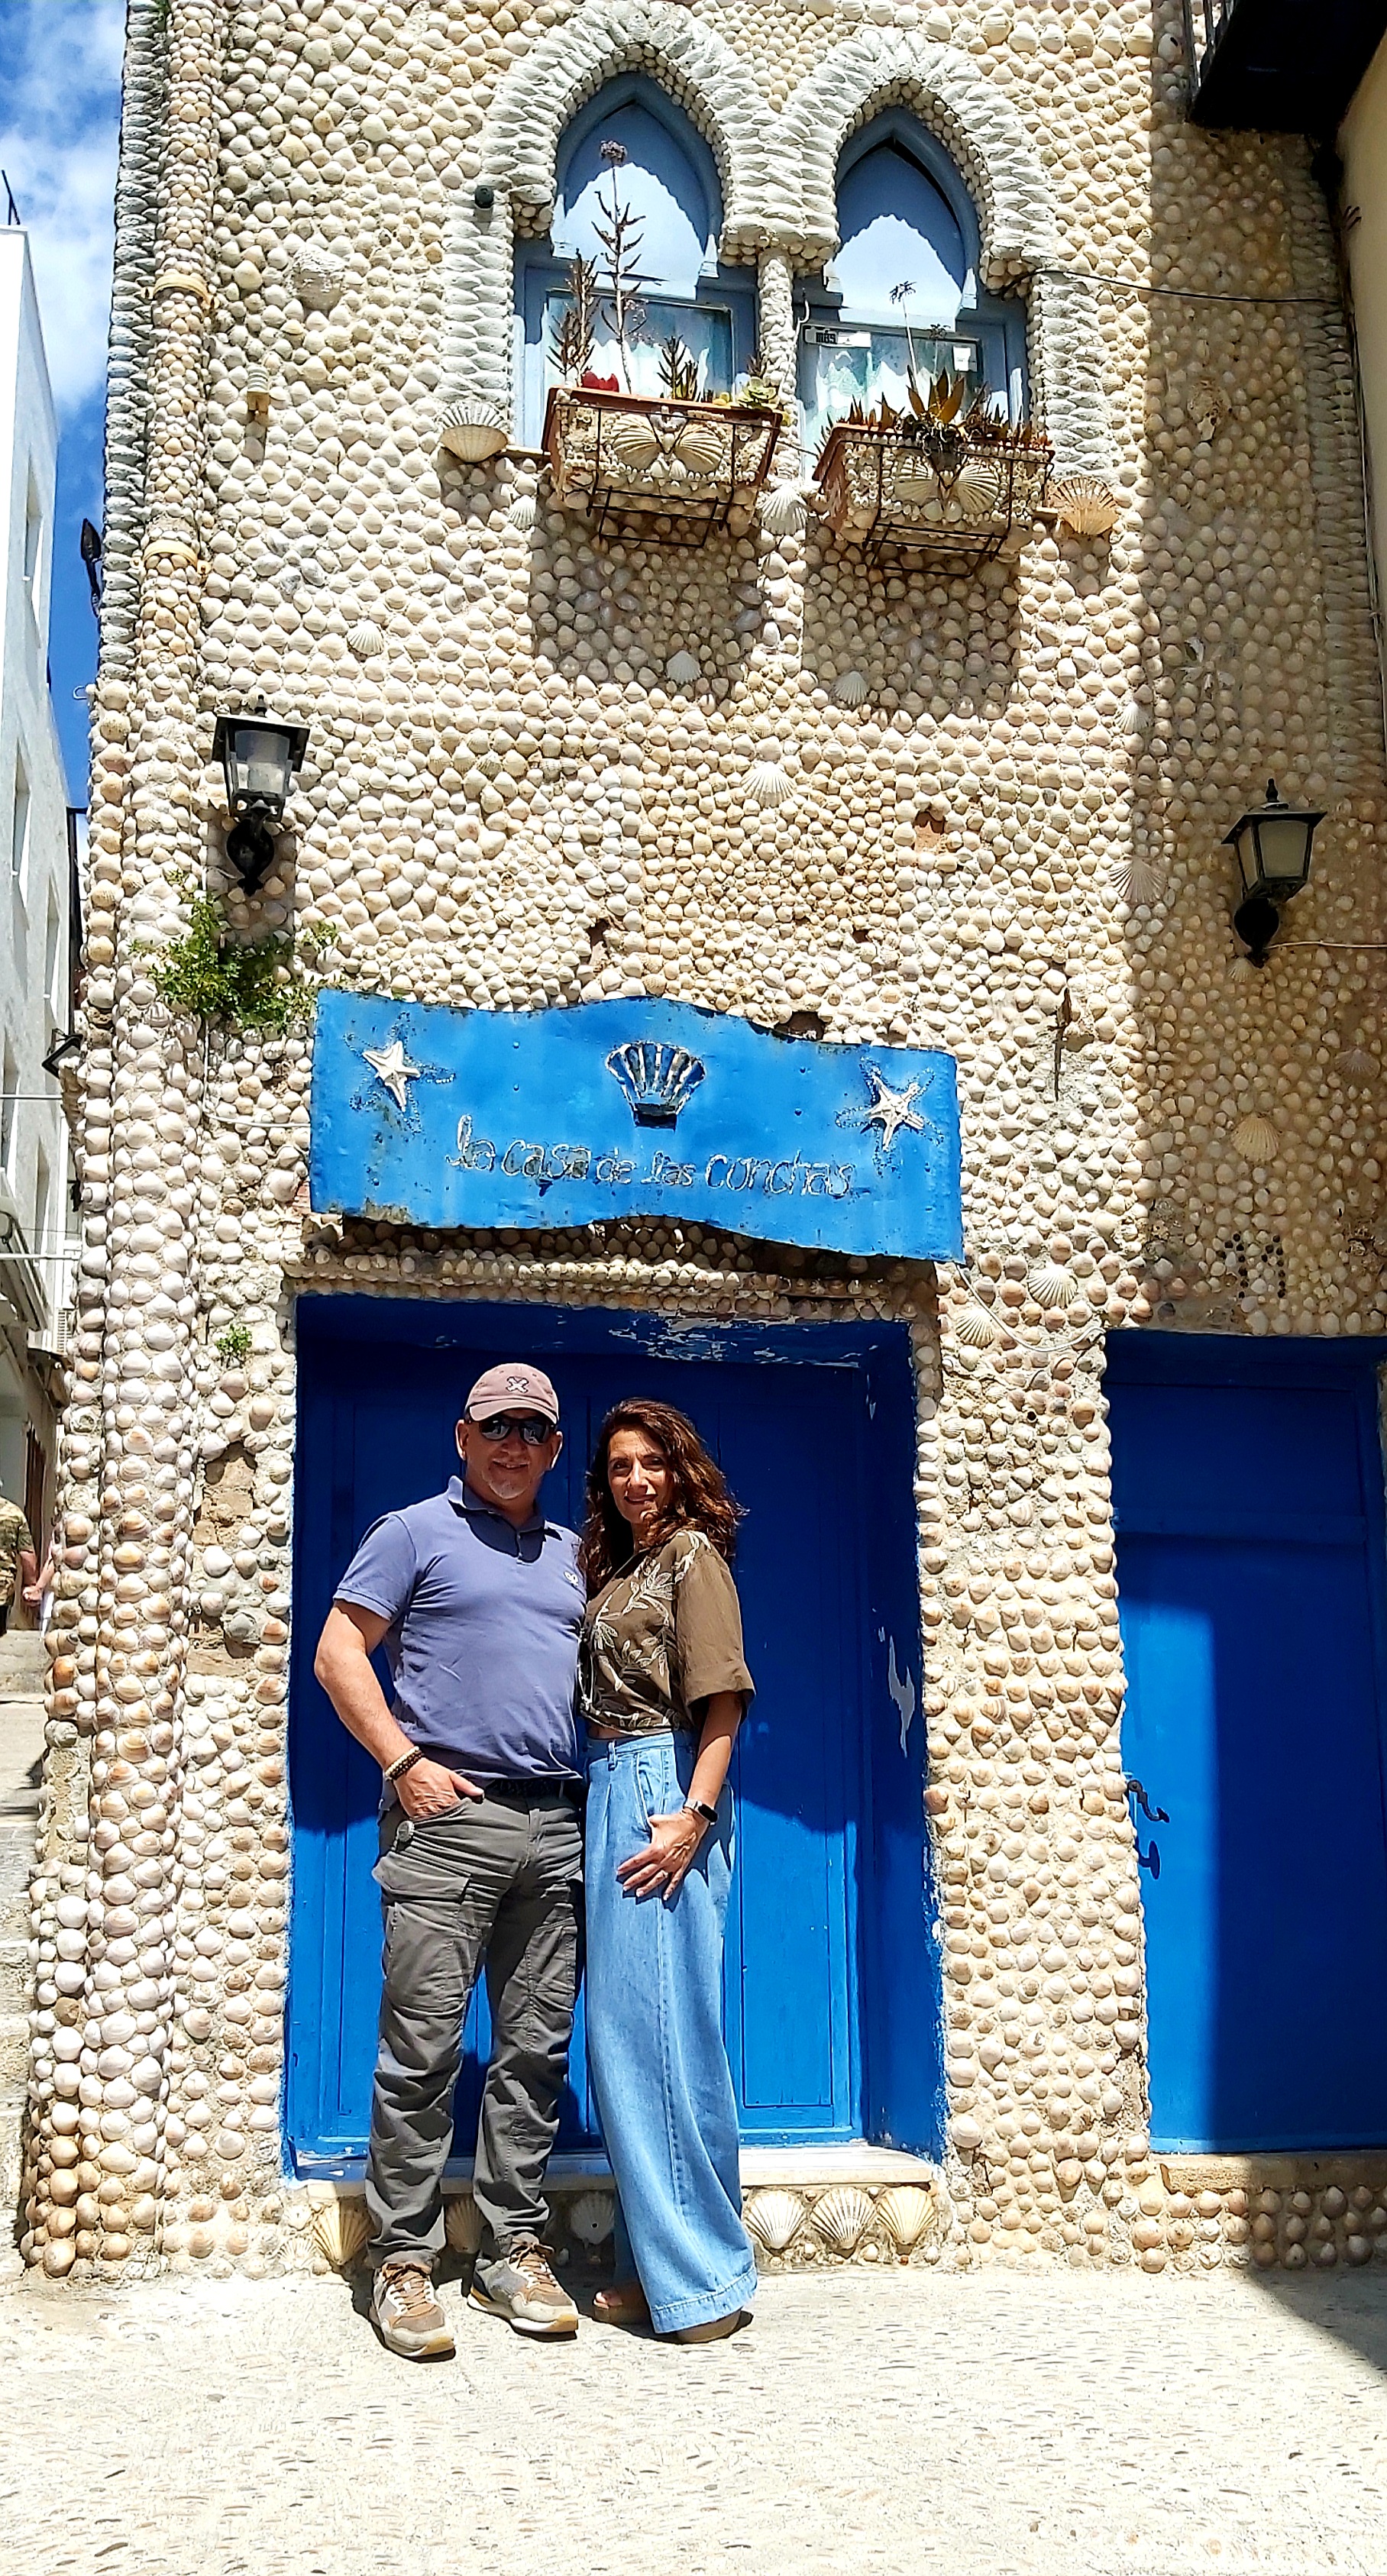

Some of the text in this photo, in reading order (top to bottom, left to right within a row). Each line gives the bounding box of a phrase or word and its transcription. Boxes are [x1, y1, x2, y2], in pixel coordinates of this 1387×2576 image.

[445, 1114, 496, 1172] la
[596, 1147, 636, 1185] de
[640, 1150, 696, 1186] las
